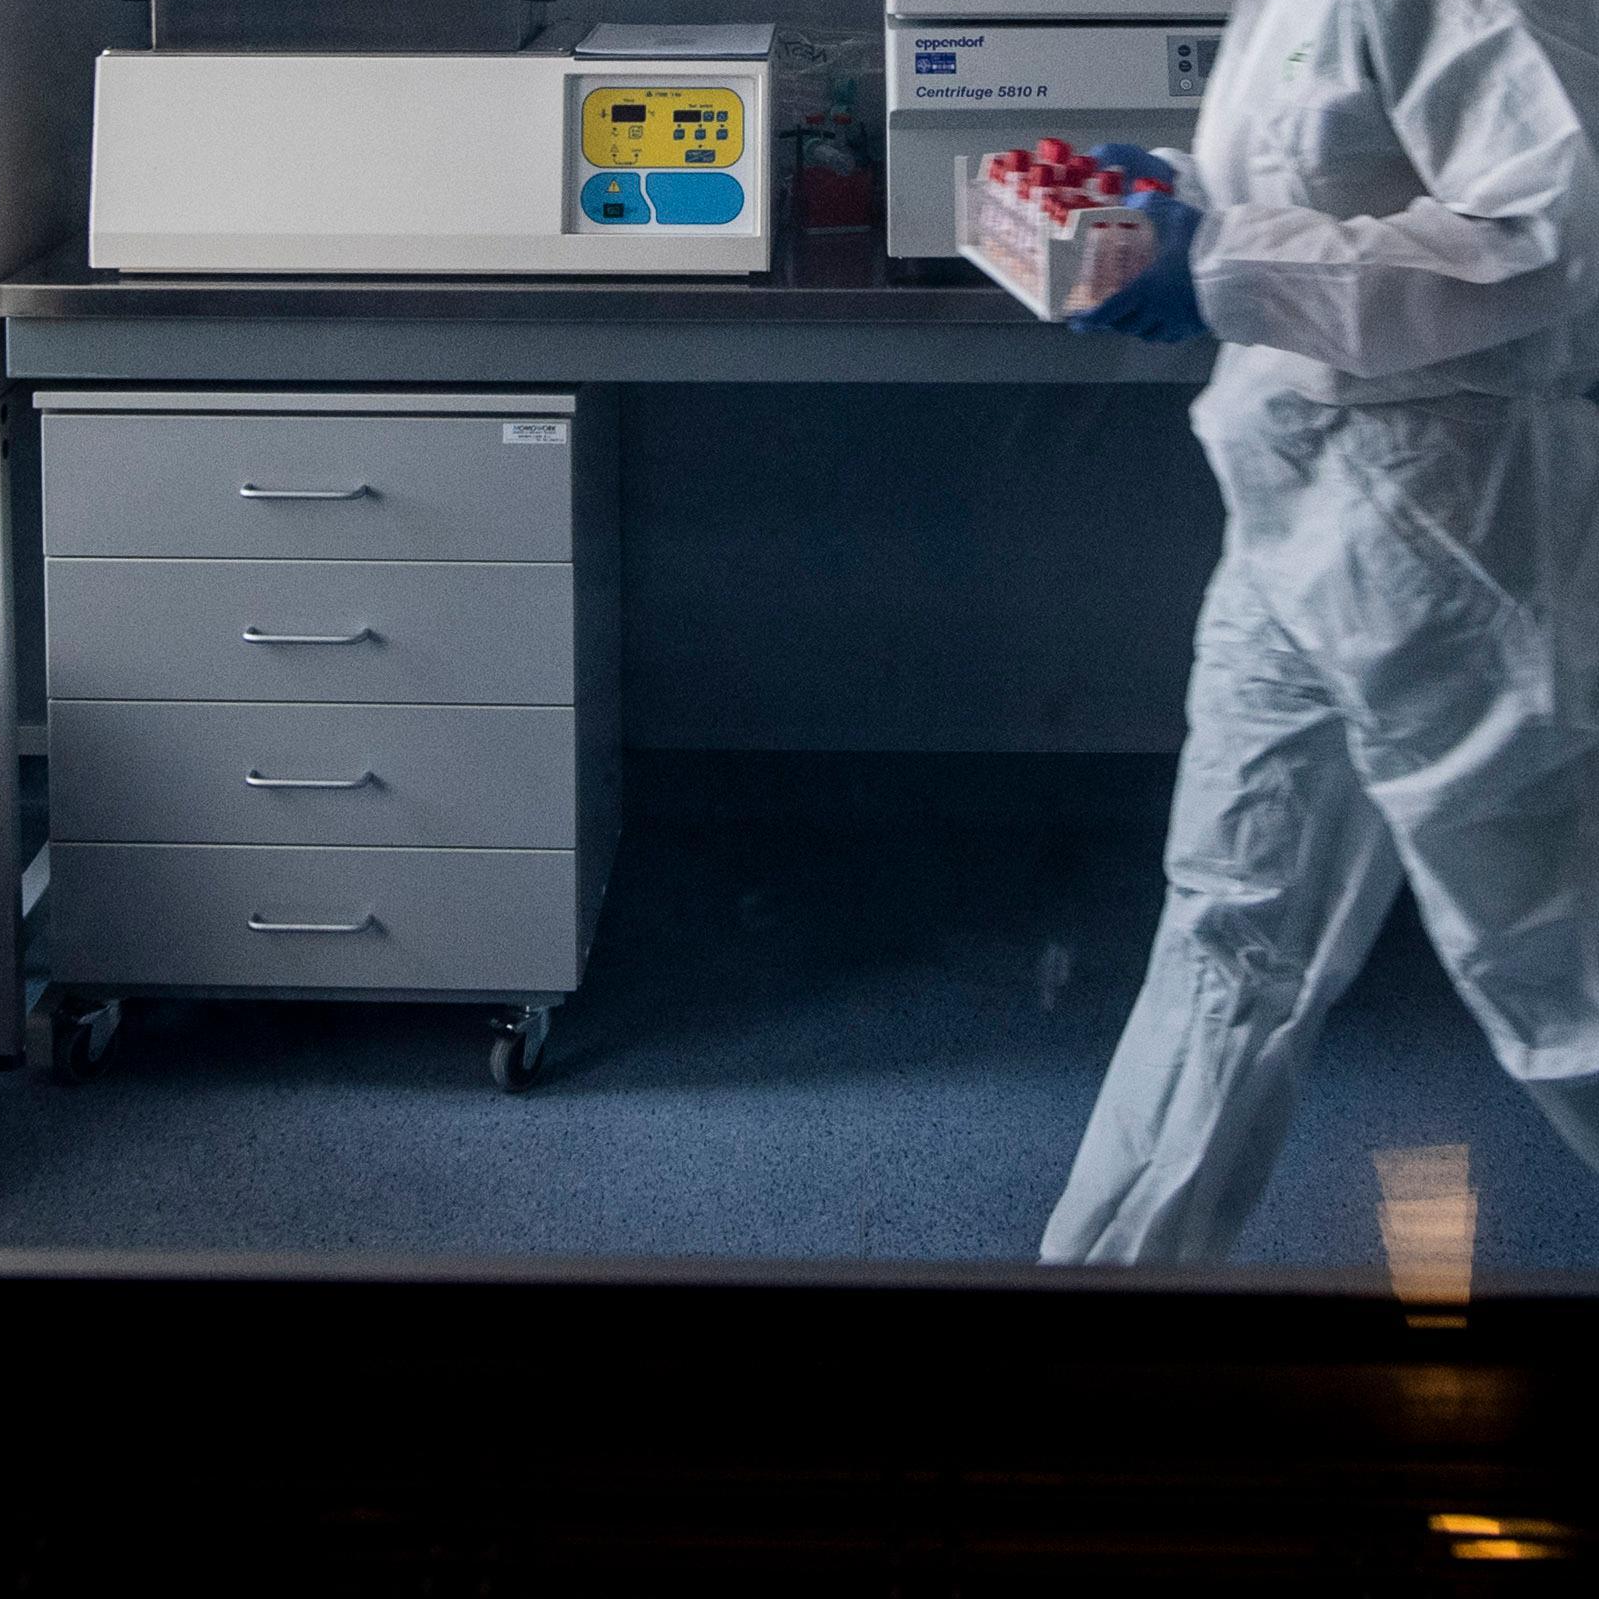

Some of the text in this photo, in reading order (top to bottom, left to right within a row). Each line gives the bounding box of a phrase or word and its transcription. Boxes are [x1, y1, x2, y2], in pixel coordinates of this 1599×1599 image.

[915, 36, 985, 51] eppendorf
[915, 85, 1049, 100] Centrifuge 5810 R
